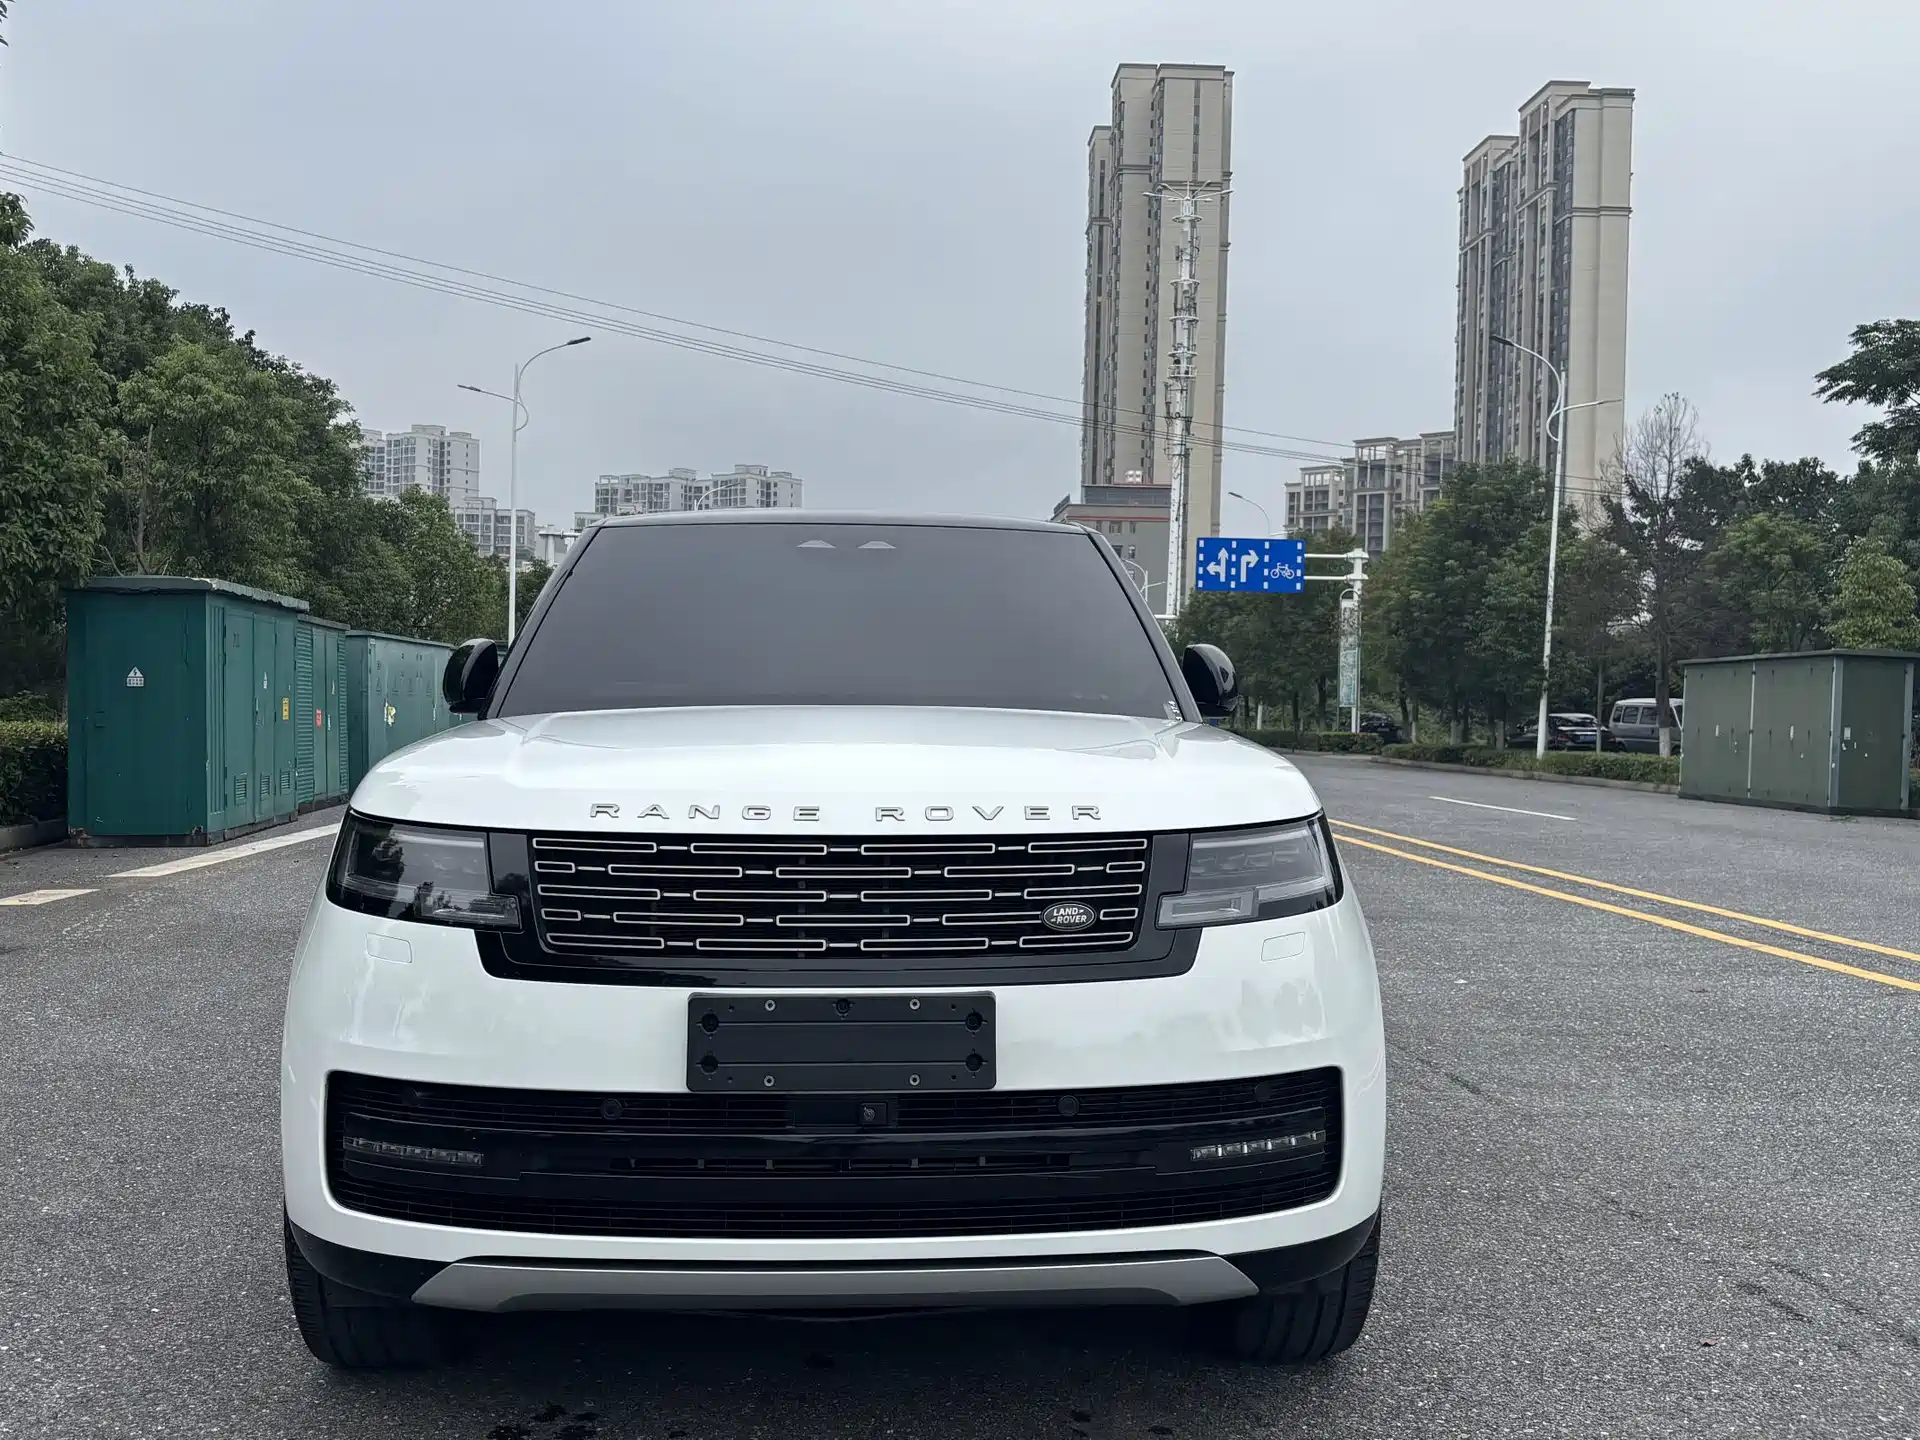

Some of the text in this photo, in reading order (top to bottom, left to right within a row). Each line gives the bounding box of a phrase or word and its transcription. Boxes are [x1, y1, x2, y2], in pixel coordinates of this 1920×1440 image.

[590, 803, 1101, 821] RANGE ROVER
[1053, 908, 1078, 916] LAND
[1056, 915, 1087, 924] ROVER
